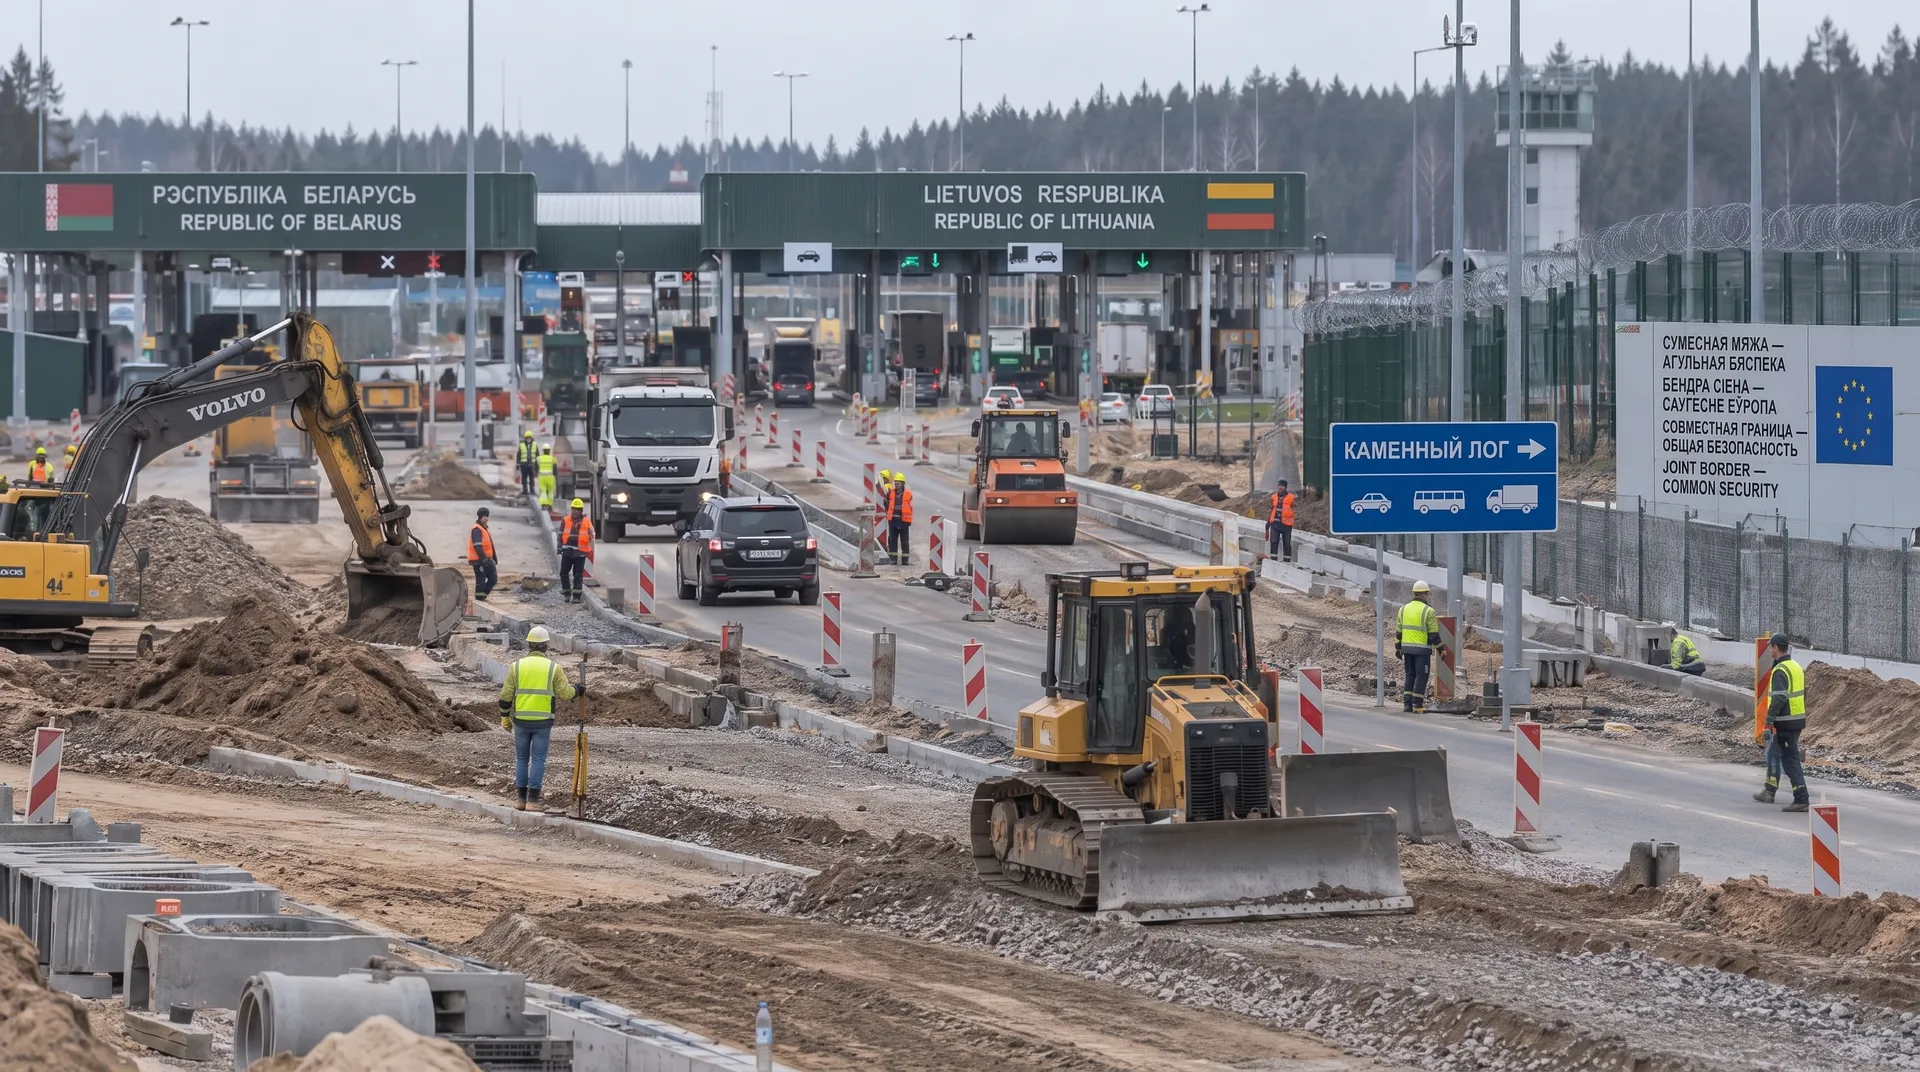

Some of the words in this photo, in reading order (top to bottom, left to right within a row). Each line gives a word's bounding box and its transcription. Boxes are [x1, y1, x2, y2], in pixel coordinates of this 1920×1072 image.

[153, 185, 287, 205] РЭСПУБЛІКА
[303, 185, 417, 205] БЕЛАРУСЬ
[924, 184, 1023, 204] LIETUVOS
[1038, 184, 1165, 204] RESPUBLIKA
[180, 213, 275, 231] REPUBLIC
[280, 213, 307, 231] OF
[313, 213, 402, 231] BELARUS
[934, 212, 1024, 230] REPUBLIC
[1029, 212, 1055, 230] OF
[1061, 212, 1156, 230] LITHUANIA
[1662, 335, 1728, 351] СУМЕСНАЯ
[1731, 336, 1769, 352] МЯЖА
[1662, 354, 1726, 370] АГУЛЬНАЯ
[1729, 356, 1786, 372] БЯСПЕКА
[1662, 377, 1710, 395] БЕНДРА
[1713, 378, 1750, 394] СІЕНА
[187, 387, 266, 421] VOLVO
[1662, 396, 1725, 413] САУГЕСНЕ
[1728, 396, 1777, 415] ЕЎРОПА
[1662, 419, 1738, 436] СОВМЕСТНАЯ
[1741, 422, 1793, 440] ГРАНИЦА
[1344, 435, 1462, 460] КАМЕННЫЙ
[1468, 440, 1510, 459] ЛОГ
[1662, 438, 1704, 455] ОБЩАЯ
[1707, 440, 1798, 457] БЕЗОПАСНОСТЬ
[1662, 460, 1697, 475] JOINT
[1700, 461, 1751, 477] BORDER
[1662, 478, 1716, 495] COMMON
[1719, 481, 1779, 498] SECURITY
